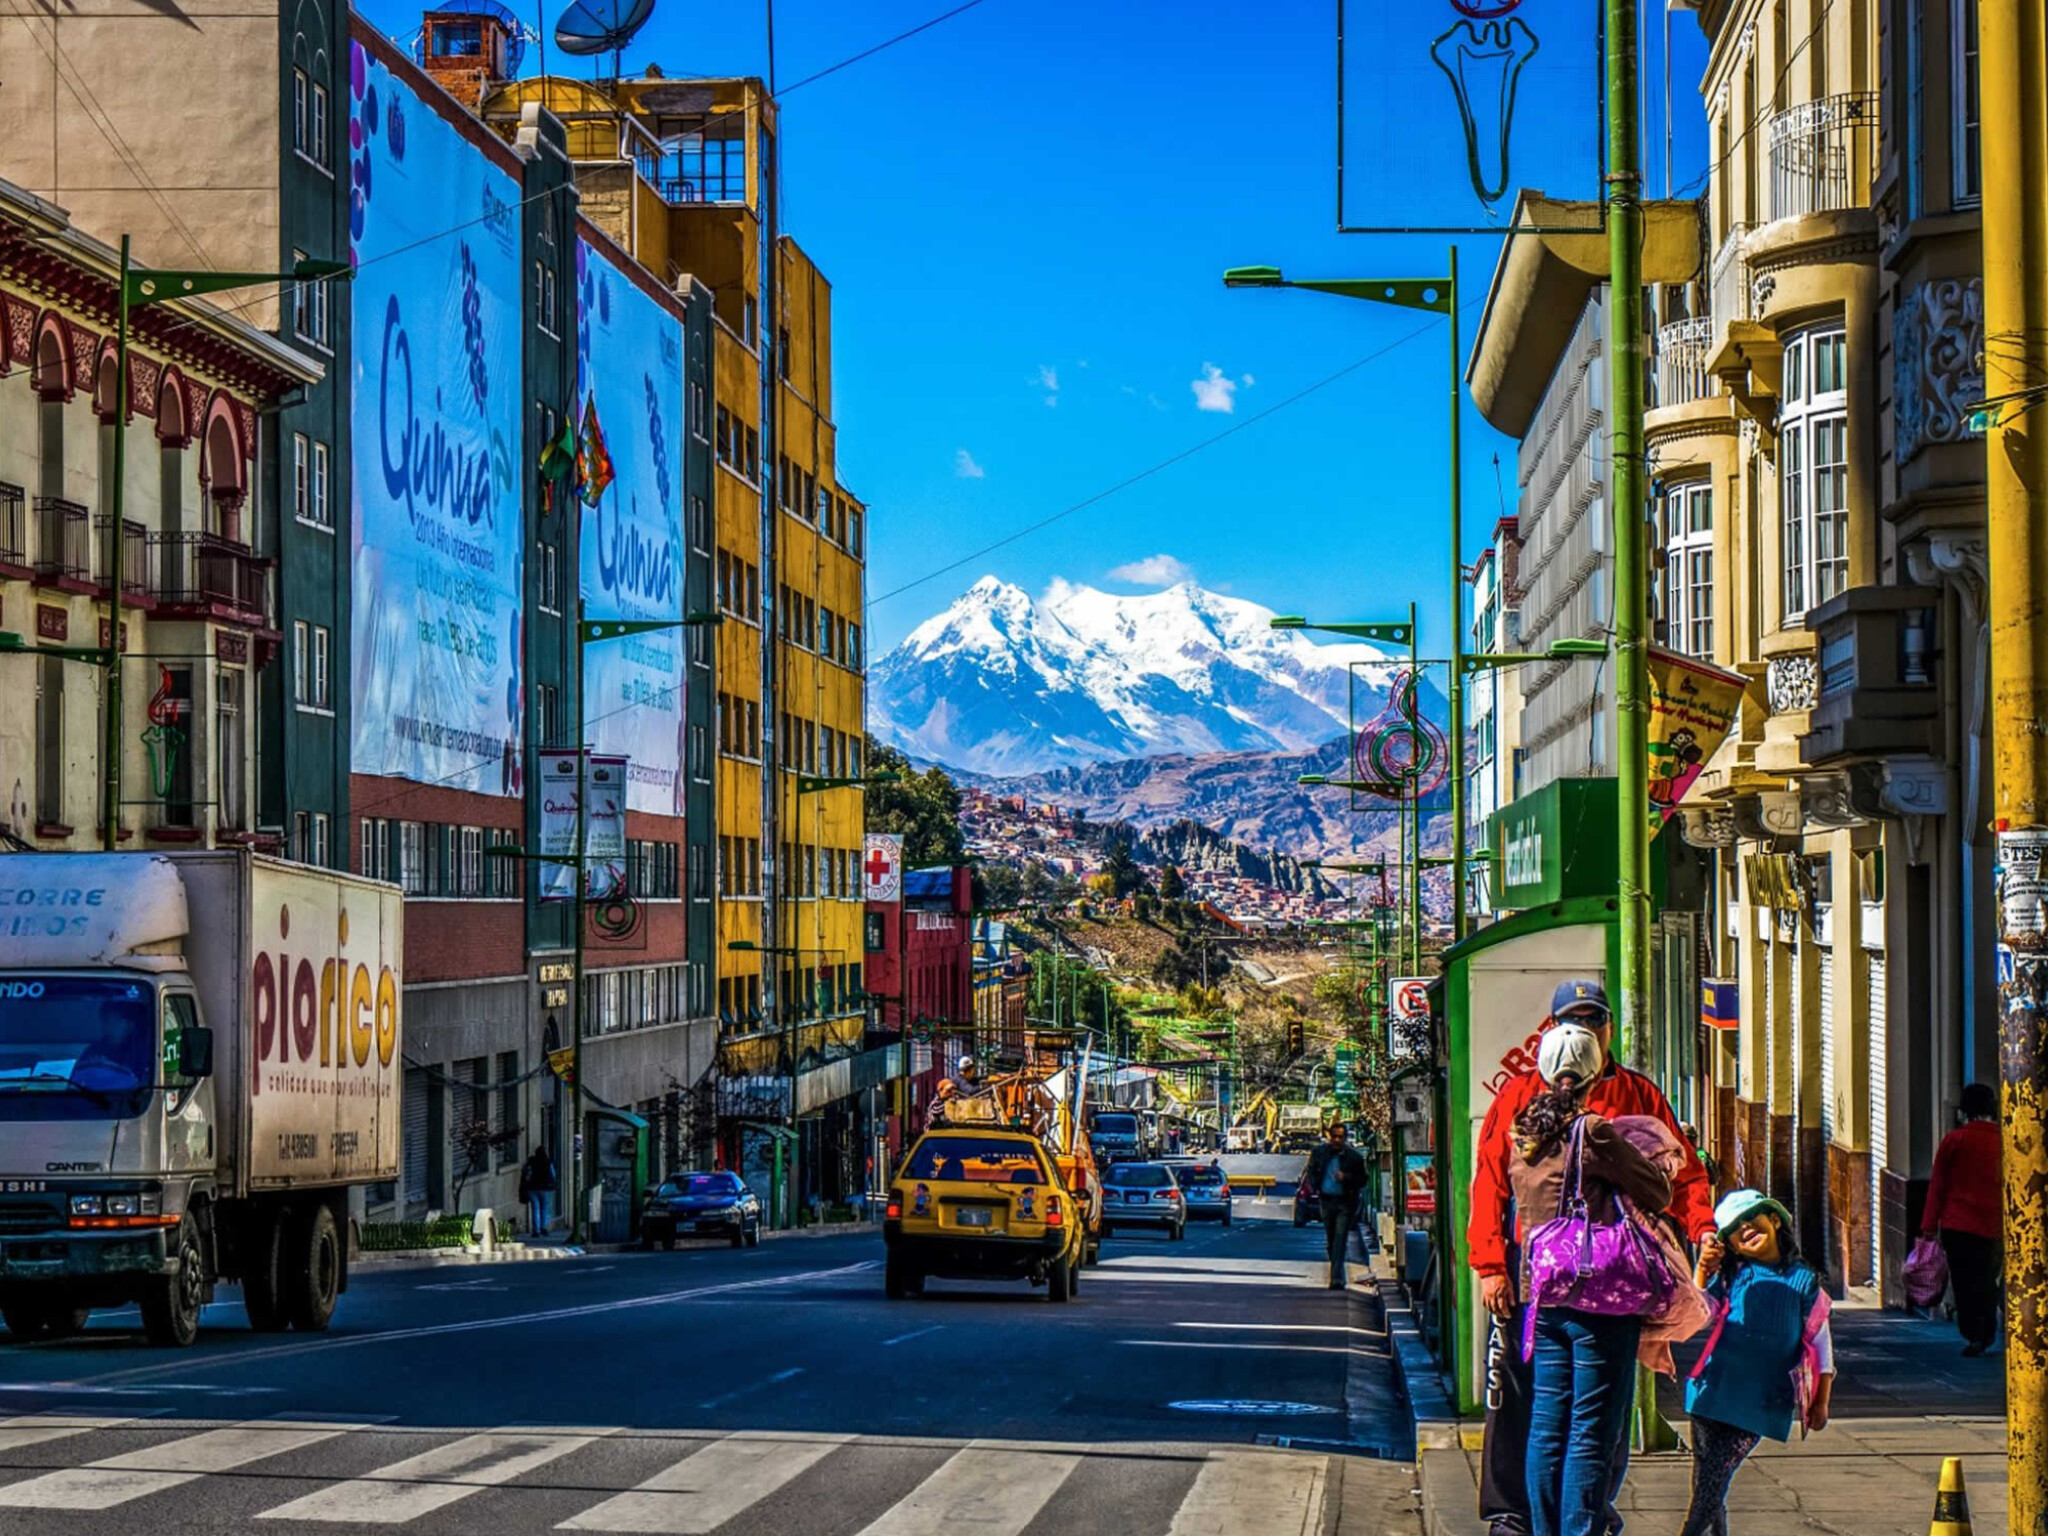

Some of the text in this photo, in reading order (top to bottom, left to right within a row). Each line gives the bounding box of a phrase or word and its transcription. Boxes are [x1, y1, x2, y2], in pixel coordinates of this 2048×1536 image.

[380, 293, 493, 529] Quinua
[416, 511, 436, 547] 2013
[0, 981, 45, 998] NDO
[253, 903, 397, 1096] piorico
[46, 1162, 103, 1173] CANTER
